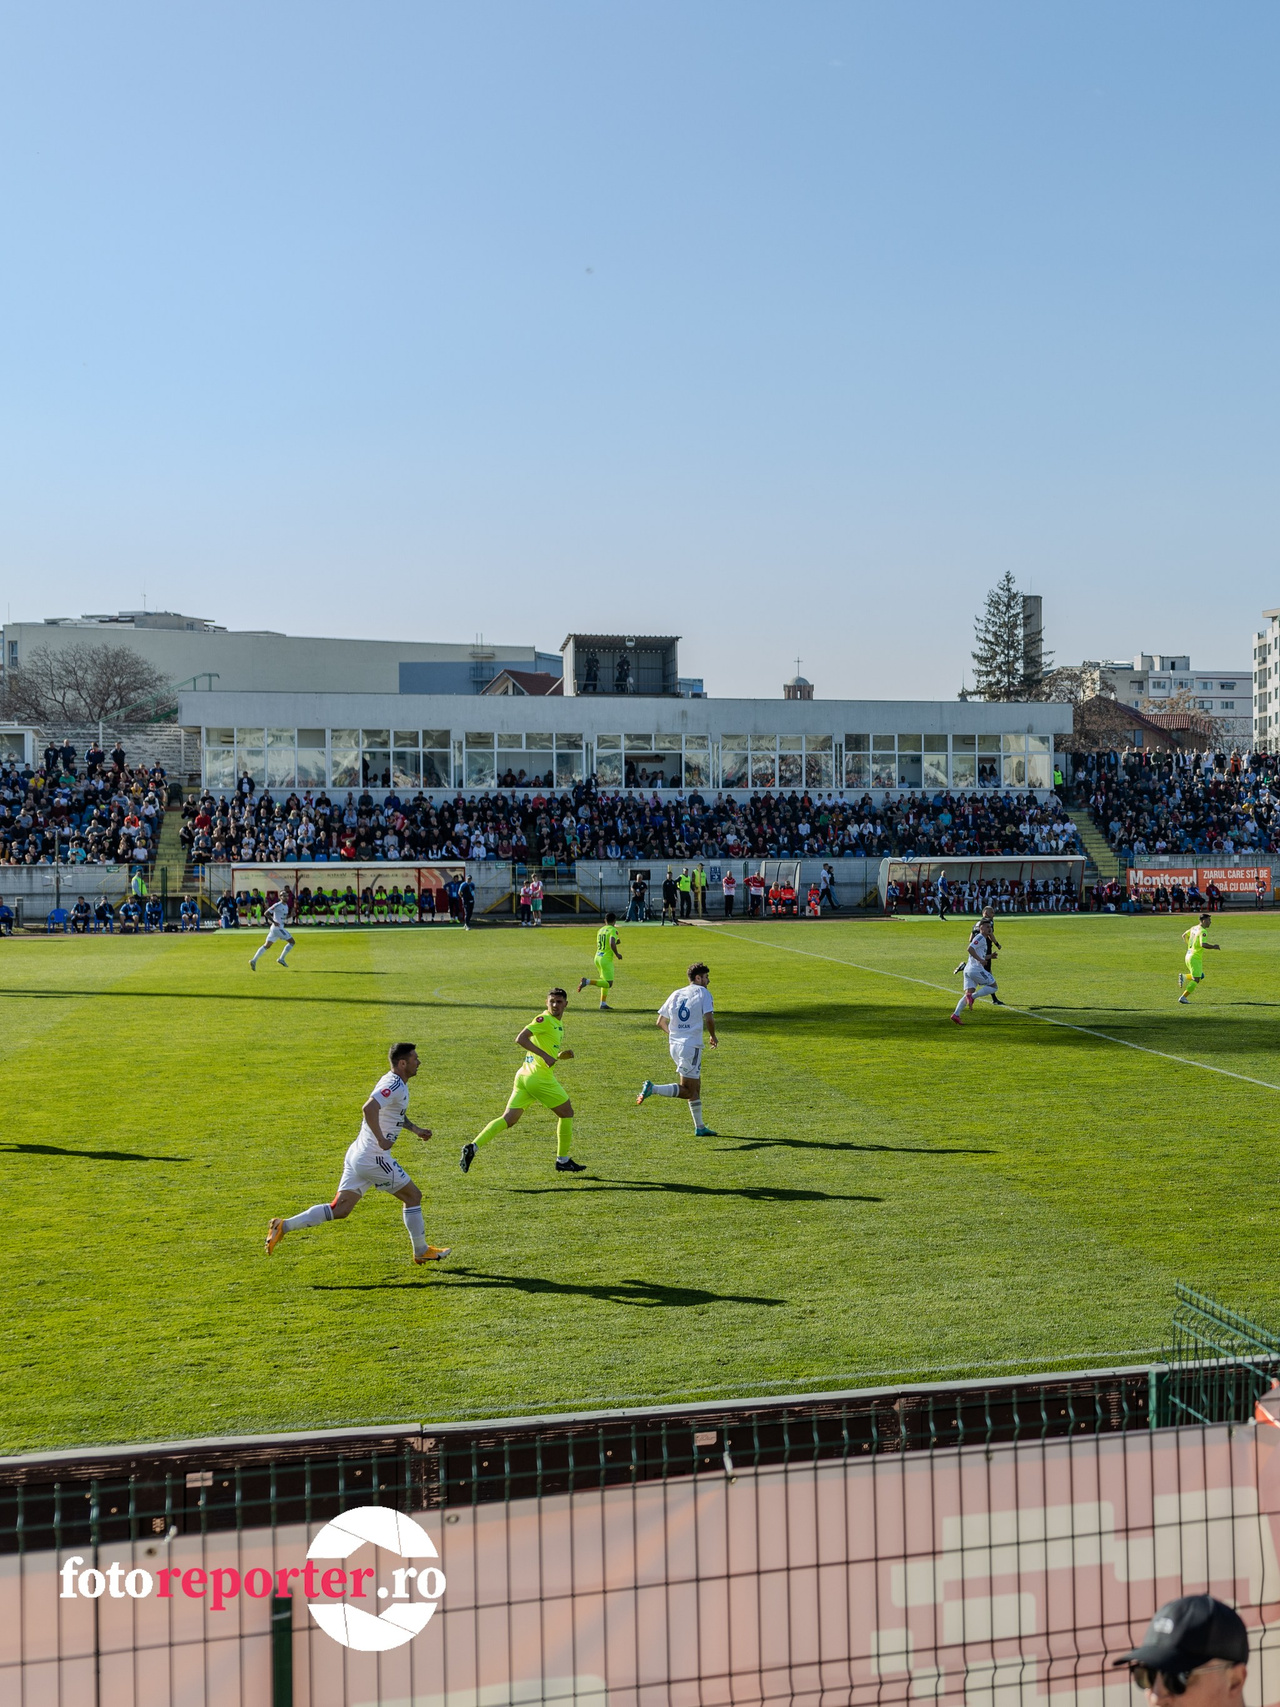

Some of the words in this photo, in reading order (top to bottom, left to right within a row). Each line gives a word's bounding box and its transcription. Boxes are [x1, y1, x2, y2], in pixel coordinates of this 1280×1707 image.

[1129, 869, 1197, 886] Monitorul
[1203, 869, 1226, 879] ZIARUL
[1227, 869, 1245, 879] CARE
[1259, 869, 1268, 878] DE
[1229, 882, 1239, 891] CU
[678, 998, 691, 1022] 6
